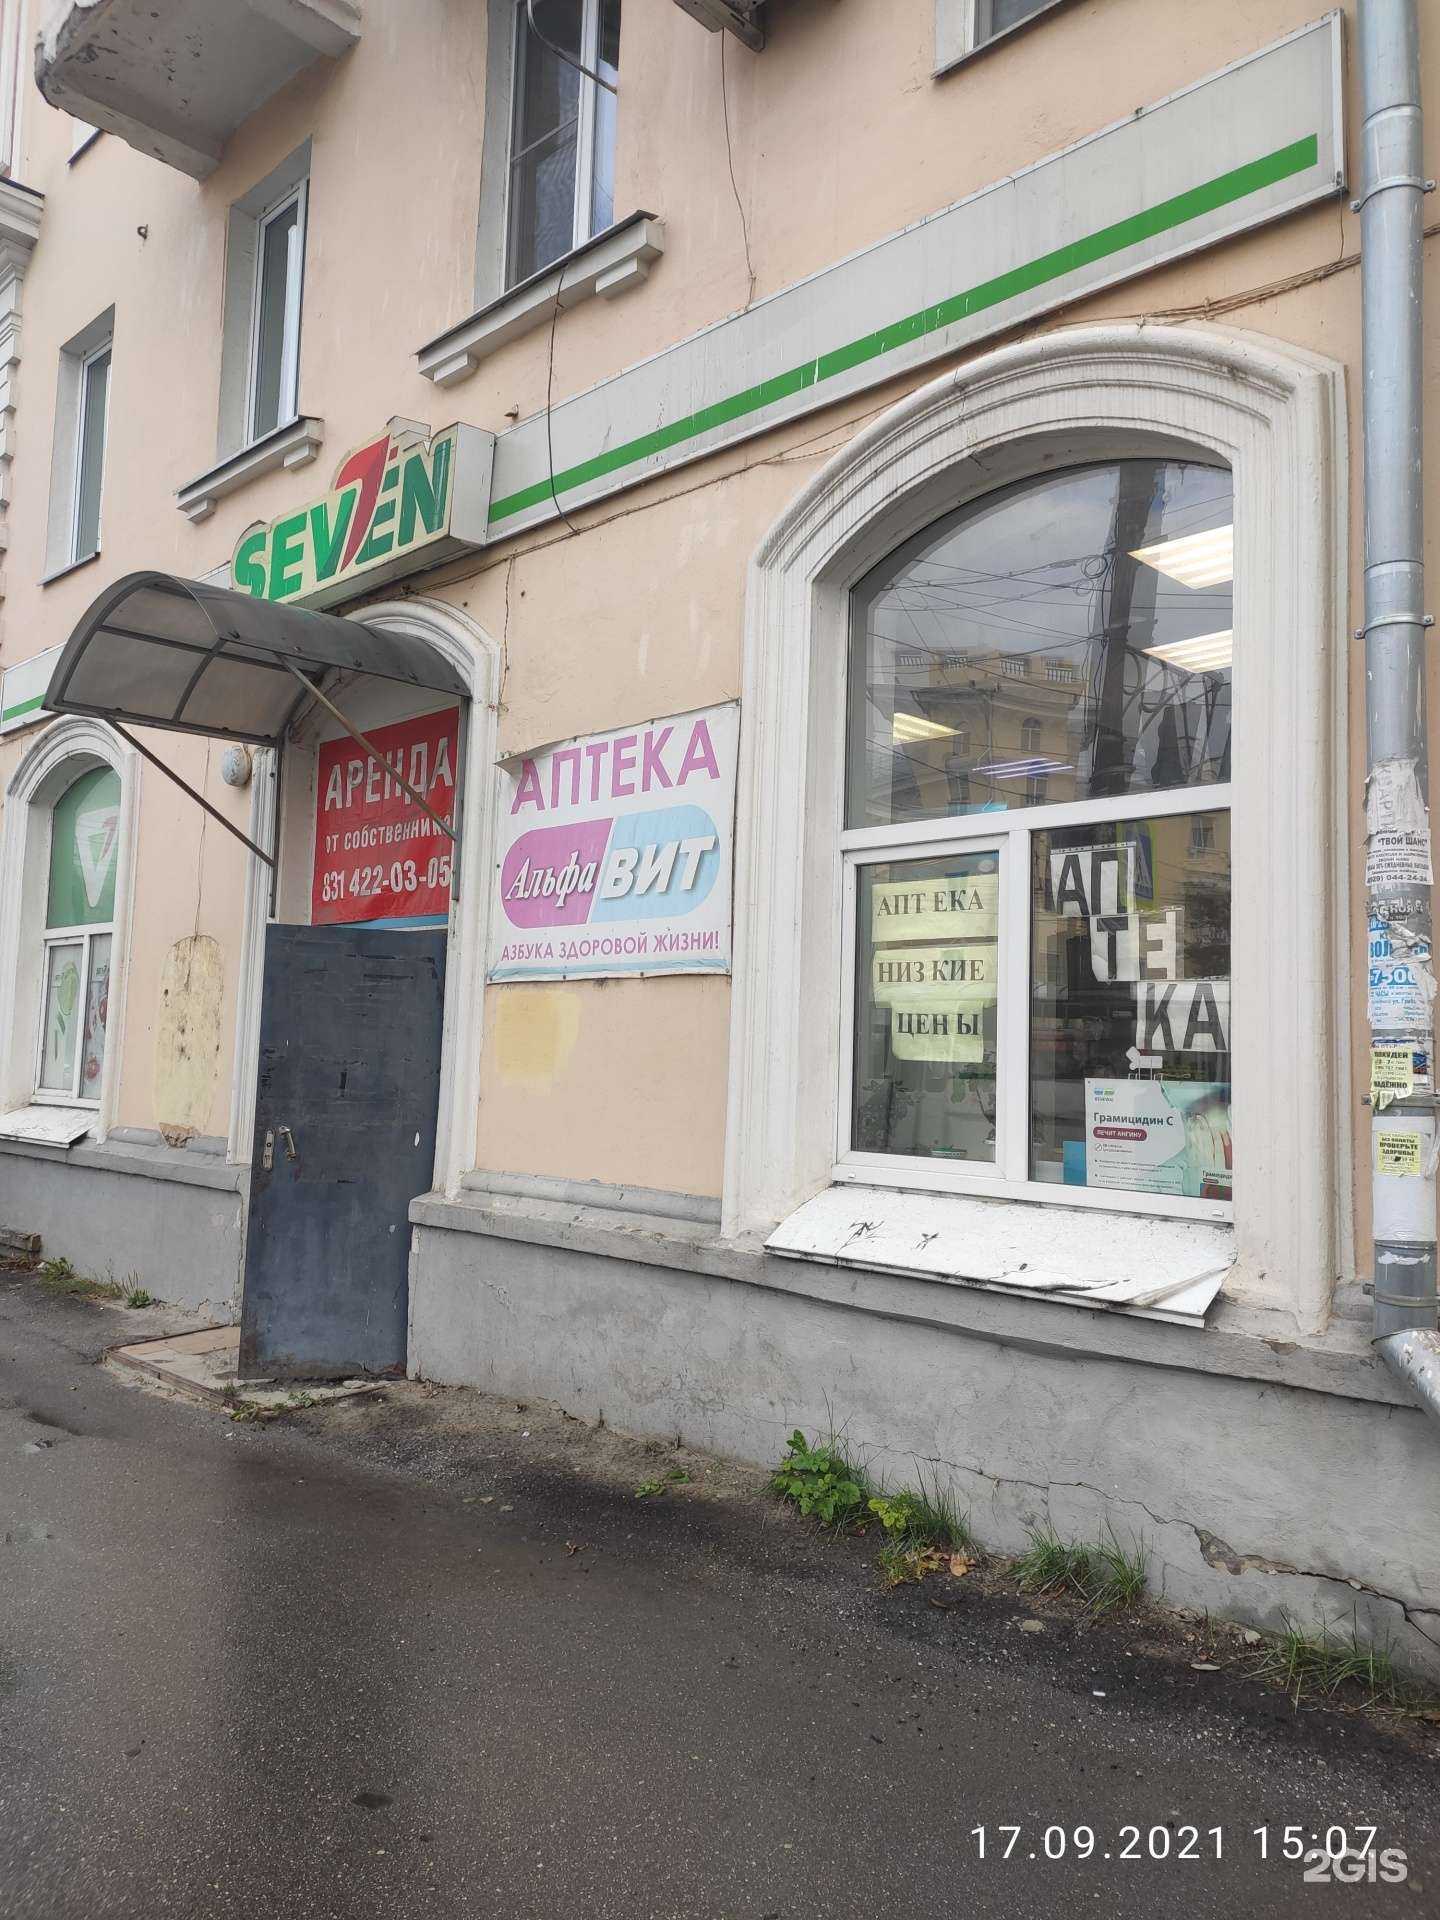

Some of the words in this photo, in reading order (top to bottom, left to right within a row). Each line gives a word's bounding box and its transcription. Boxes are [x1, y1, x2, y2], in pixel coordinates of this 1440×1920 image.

[324, 737, 454, 812] АРЕНДА
[510, 719, 720, 815] АПТЕКА
[322, 870, 345, 902] 831
[350, 856, 450, 897] 422-03-05
[501, 942, 553, 961] АЗБУКА
[558, 932, 648, 959] ЗДОРОВОЙ
[653, 931, 719, 952] ЖИЗНИ!
[1093, 1112, 1163, 1126] Грамицидин
